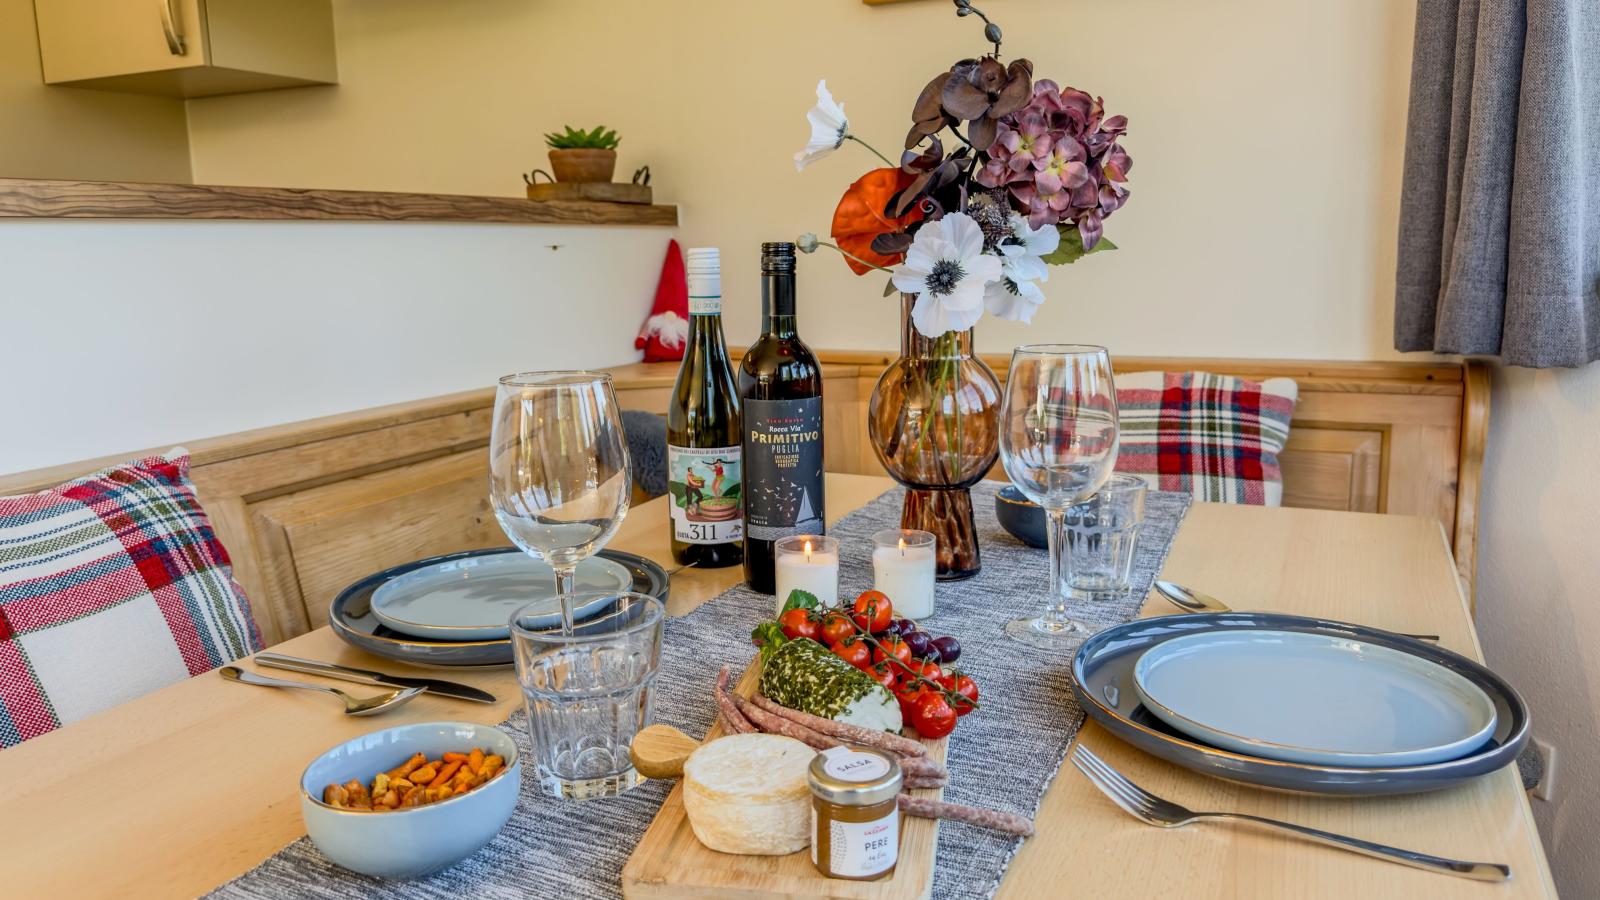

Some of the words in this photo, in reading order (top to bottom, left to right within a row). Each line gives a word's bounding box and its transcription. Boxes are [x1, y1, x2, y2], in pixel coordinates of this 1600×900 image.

[751, 430, 819, 444] PRIMITIVO
[771, 444, 800, 454] PUGLIA
[689, 524, 717, 540] 311
[836, 759, 872, 772] SALSA
[864, 836, 888, 852] PERE
